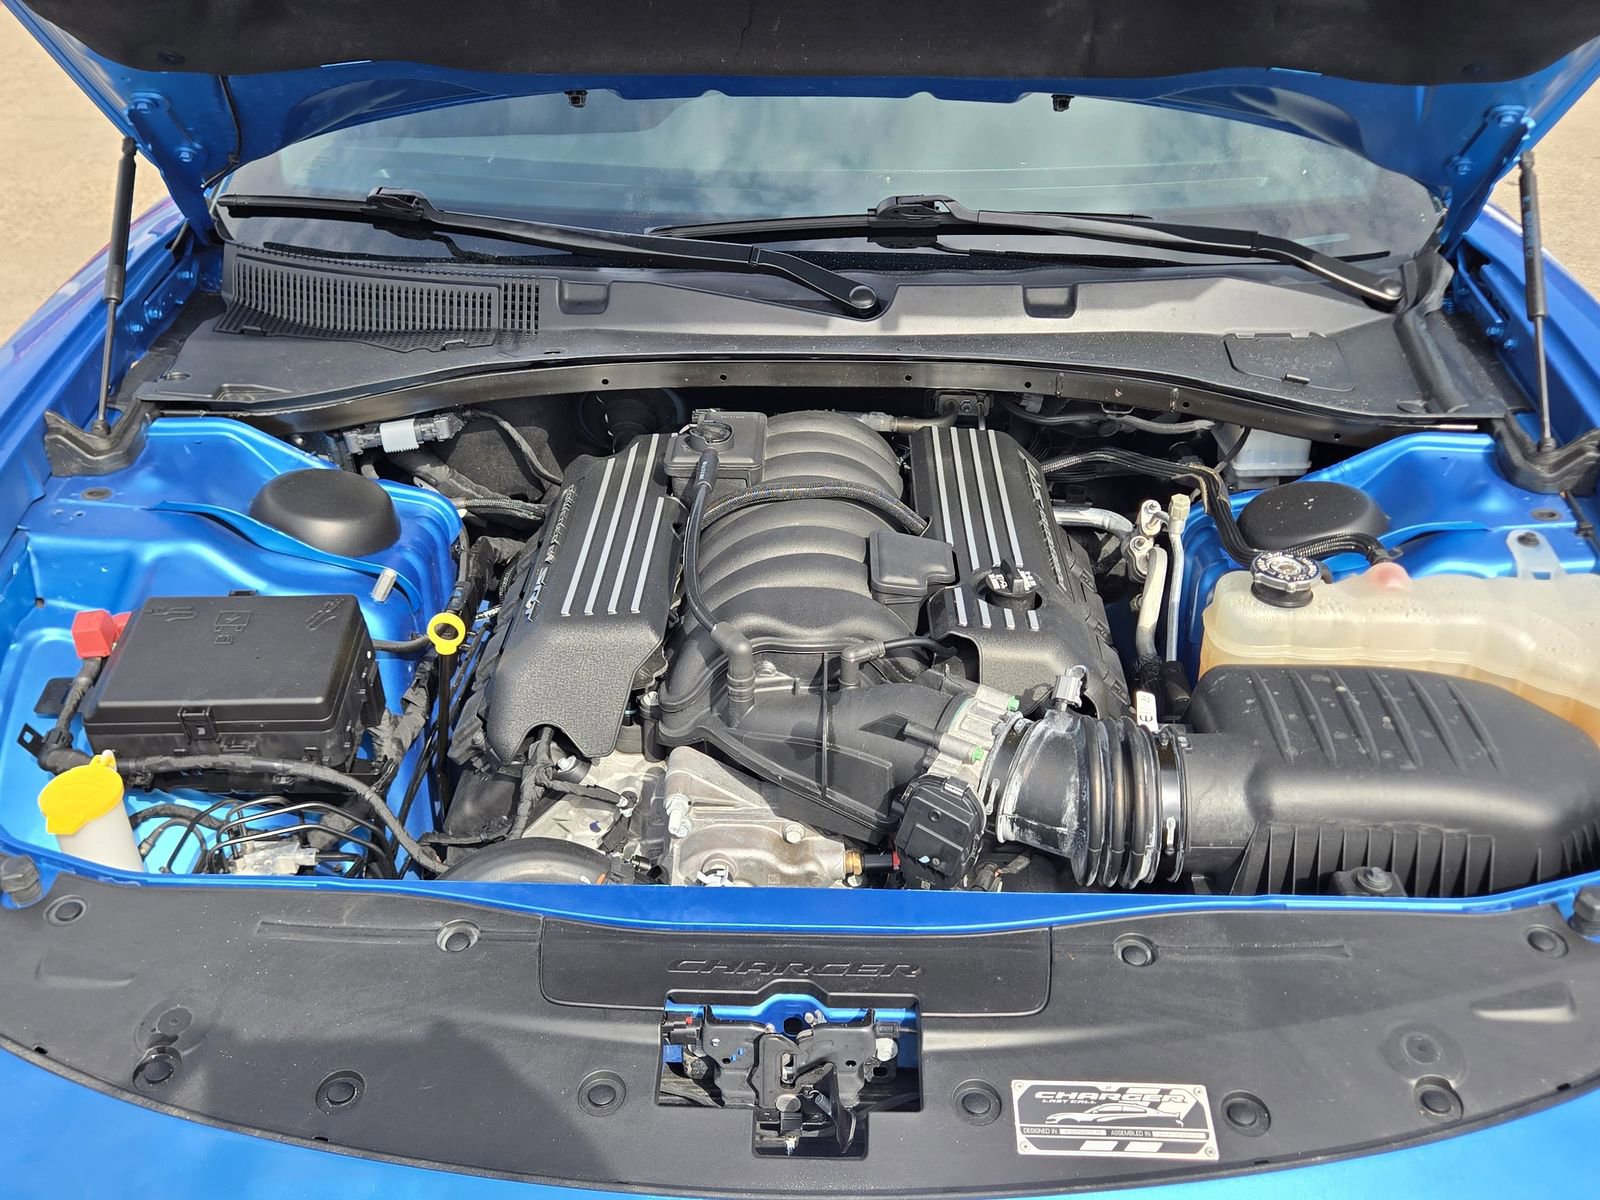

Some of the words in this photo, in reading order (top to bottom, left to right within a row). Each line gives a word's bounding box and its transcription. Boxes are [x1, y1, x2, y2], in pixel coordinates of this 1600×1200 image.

[525, 566, 549, 622] SRT
[666, 959, 922, 977] CHARGER
[1034, 1091, 1188, 1104] CHARGER
[1023, 1127, 1051, 1135] DESIGNED
[1110, 1129, 1143, 1137] ASSEMBLED
